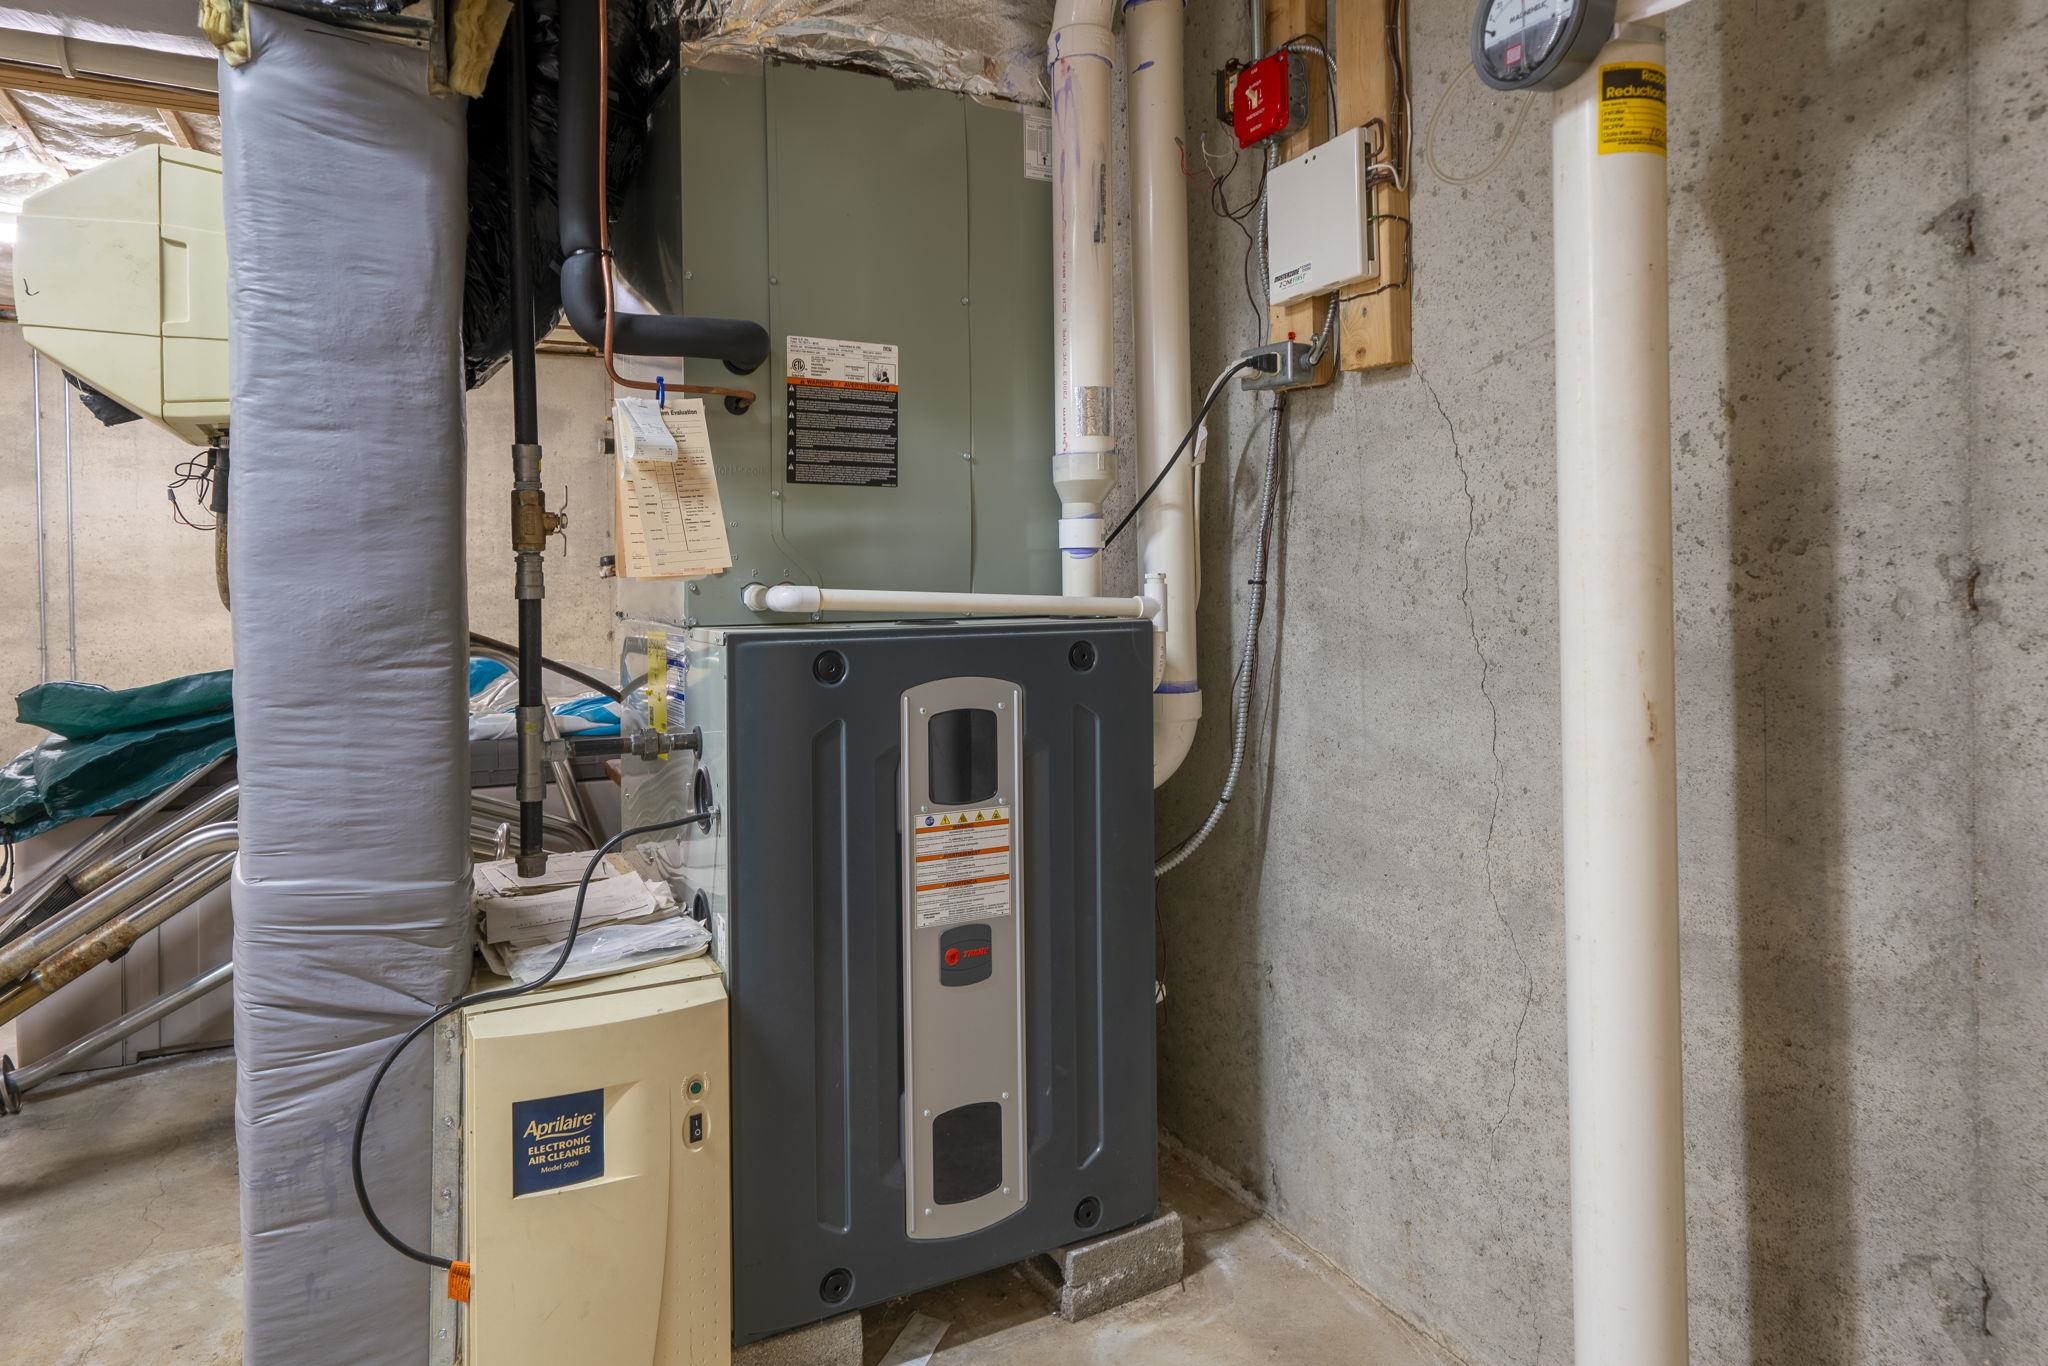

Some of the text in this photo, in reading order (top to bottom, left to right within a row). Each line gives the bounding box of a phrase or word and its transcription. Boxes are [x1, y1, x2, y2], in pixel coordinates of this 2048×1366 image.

[1642, 69, 1665, 84] Rado
[523, 1113, 593, 1141] Aprilaire
[528, 1135, 591, 1156] ELECTRONIC
[528, 1145, 591, 1166] AIR CLEANER
[540, 1160, 579, 1174] Model 5000
